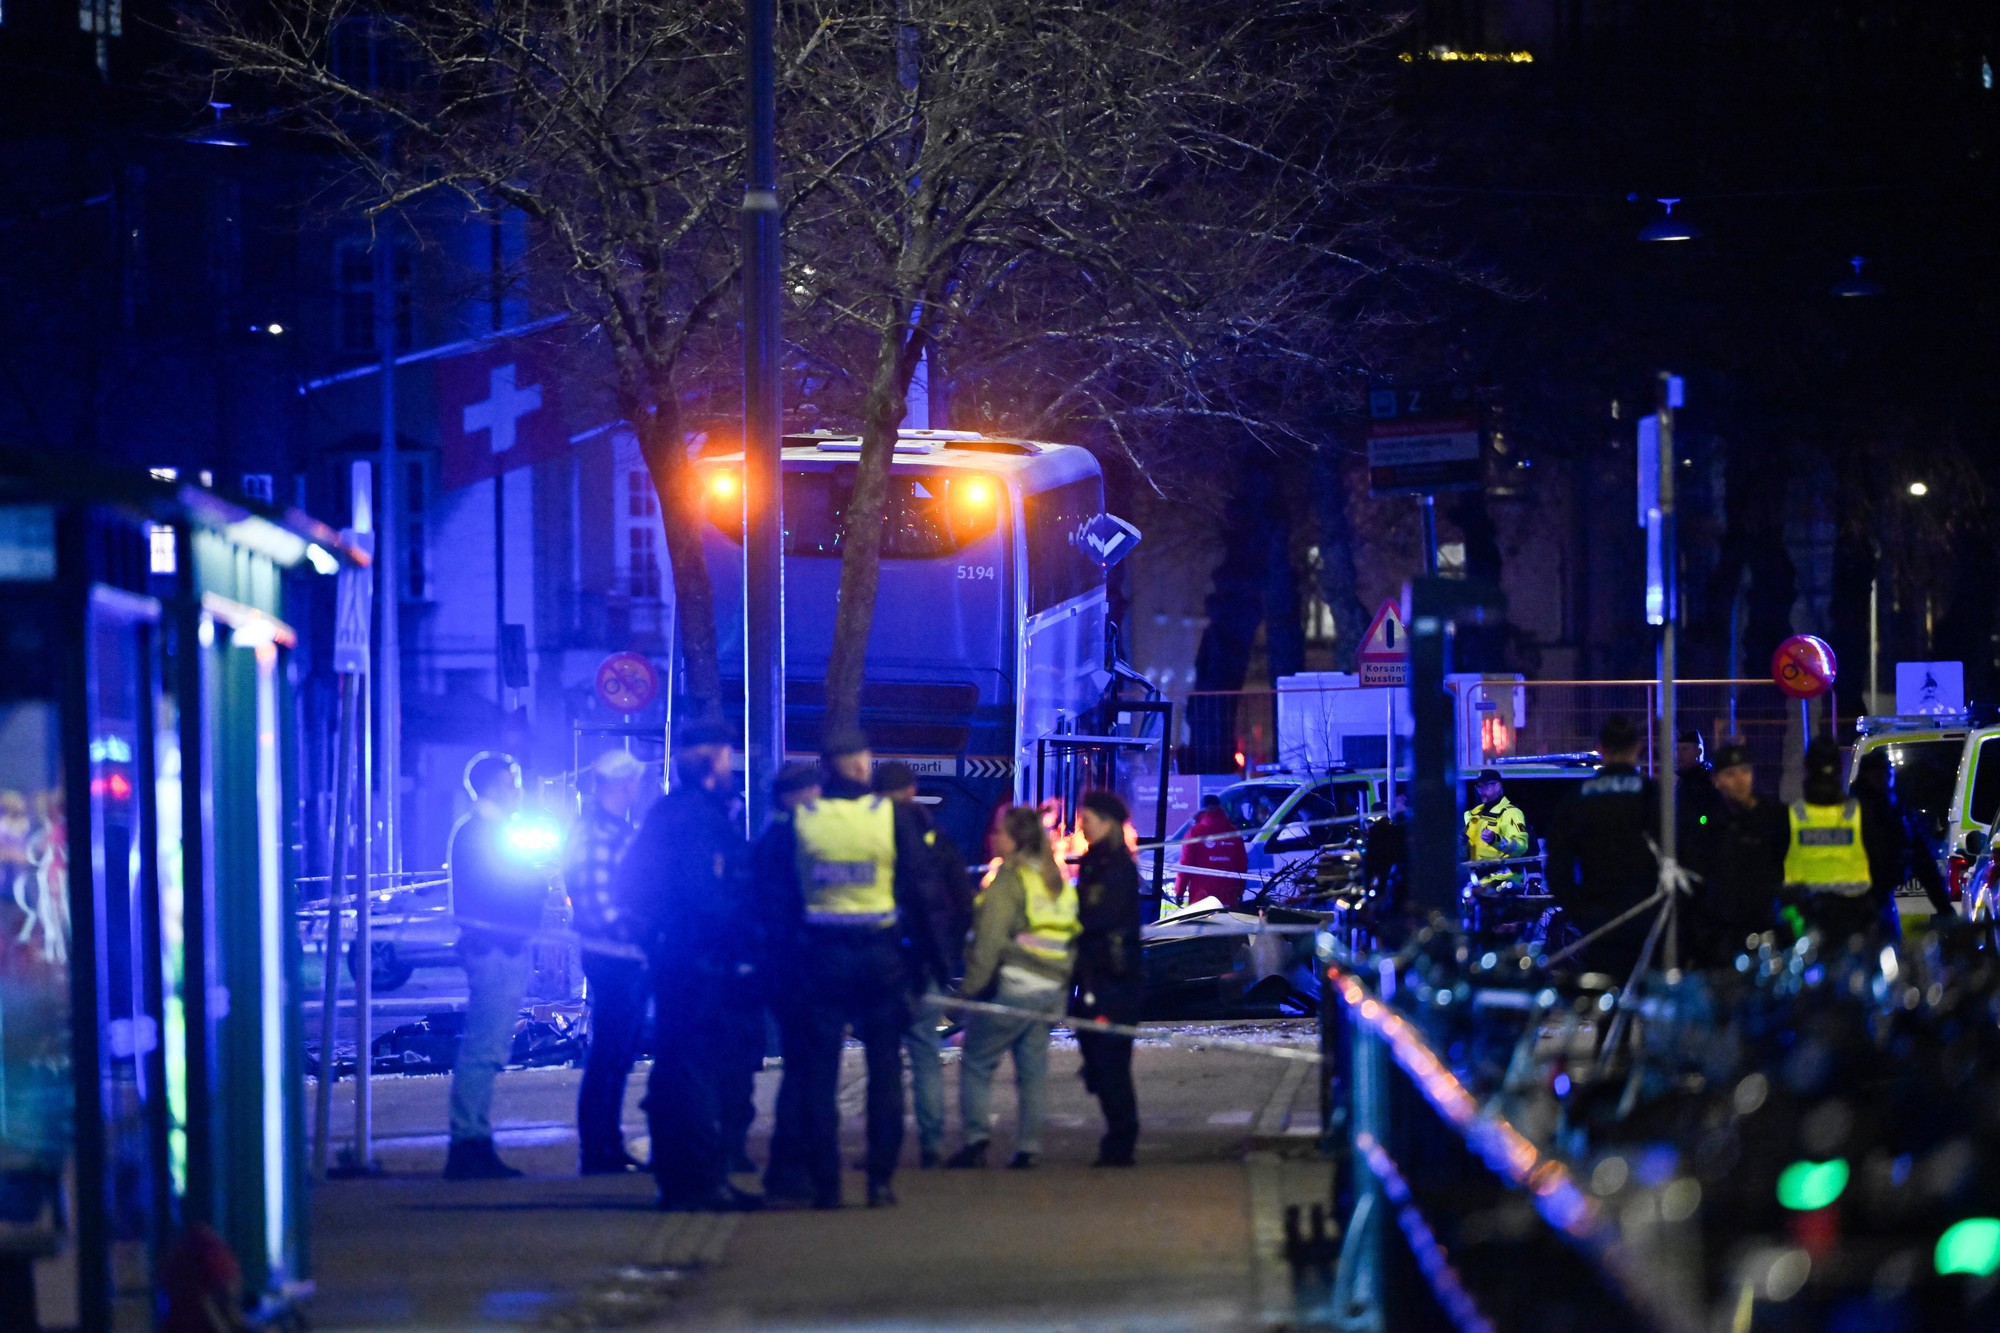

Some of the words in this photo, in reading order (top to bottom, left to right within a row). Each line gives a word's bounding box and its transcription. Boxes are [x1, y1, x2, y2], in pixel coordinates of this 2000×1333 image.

[1408, 391, 1422, 412] Z
[957, 565, 995, 580] 5194
[1366, 664, 1408, 673] Korsand
